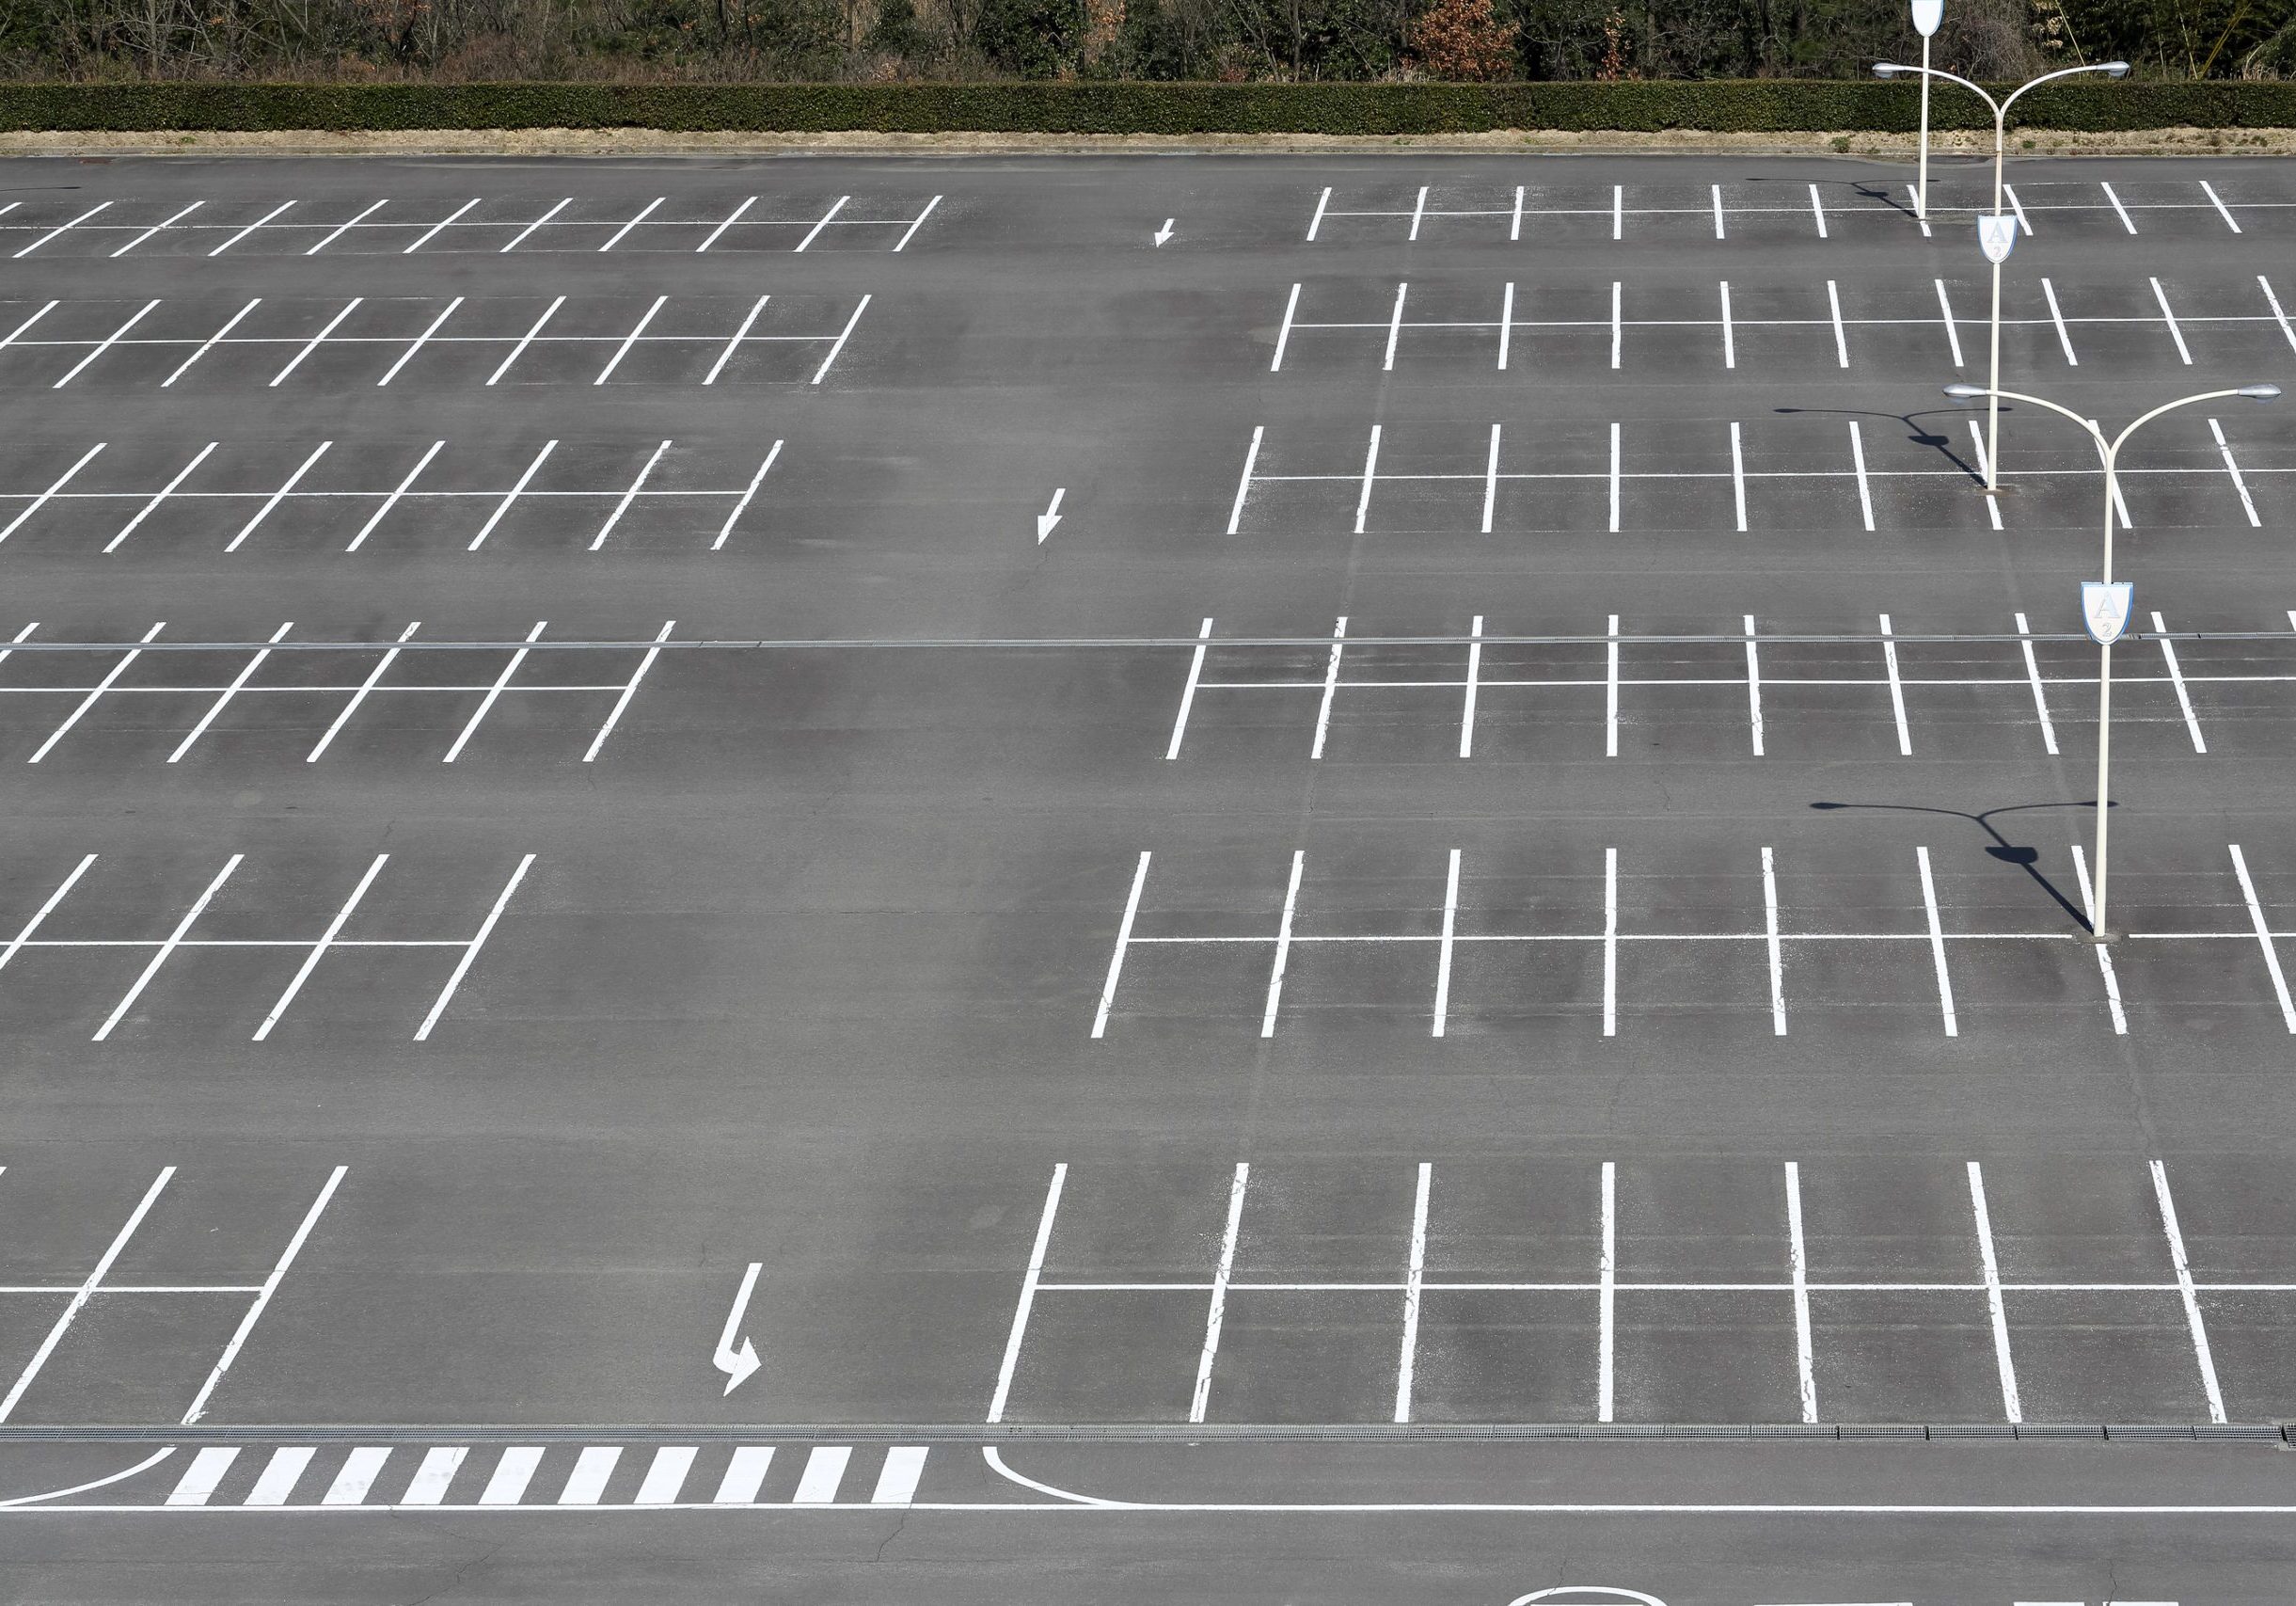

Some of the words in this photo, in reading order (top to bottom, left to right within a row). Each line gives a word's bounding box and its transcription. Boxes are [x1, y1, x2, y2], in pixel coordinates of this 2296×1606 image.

[1987, 221, 2009, 244] A
[1993, 246, 2002, 258] 2
[2093, 591, 2121, 619] A
[2102, 622, 2113, 637] 2
